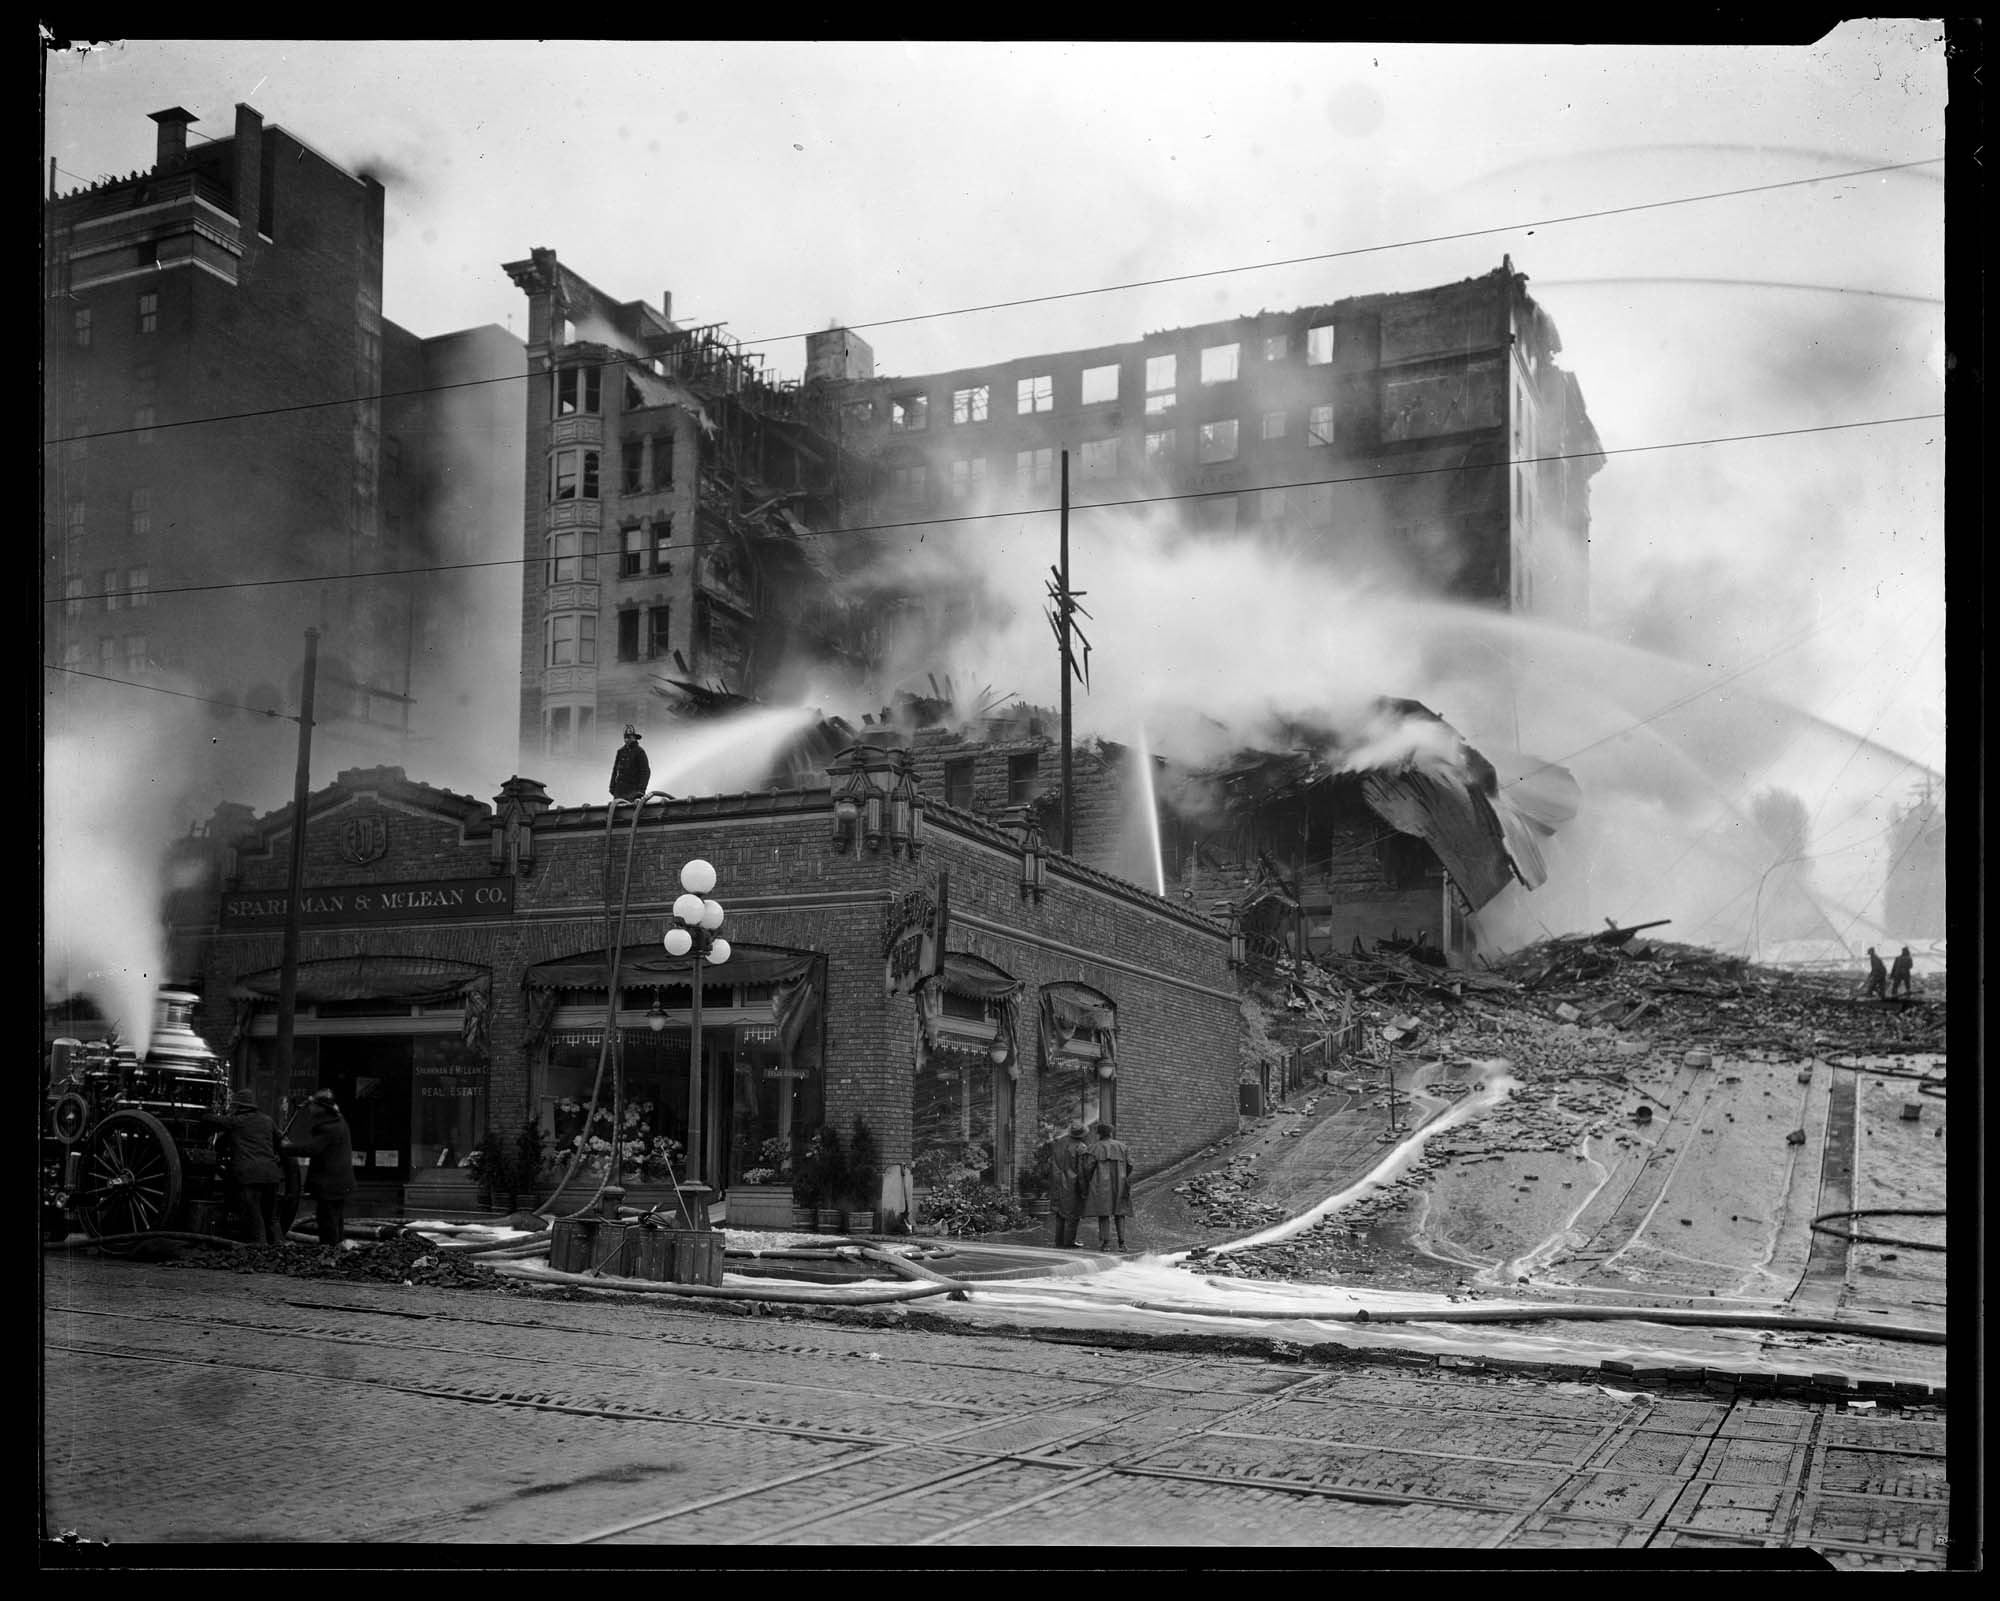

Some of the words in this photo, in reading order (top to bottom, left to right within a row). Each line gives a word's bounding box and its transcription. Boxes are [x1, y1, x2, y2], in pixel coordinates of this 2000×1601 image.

[354, 895, 372, 911] &
[475, 887, 507, 904] CO.
[421, 1087, 445, 1097] REAL
[448, 1087, 485, 1097] ESTATE
